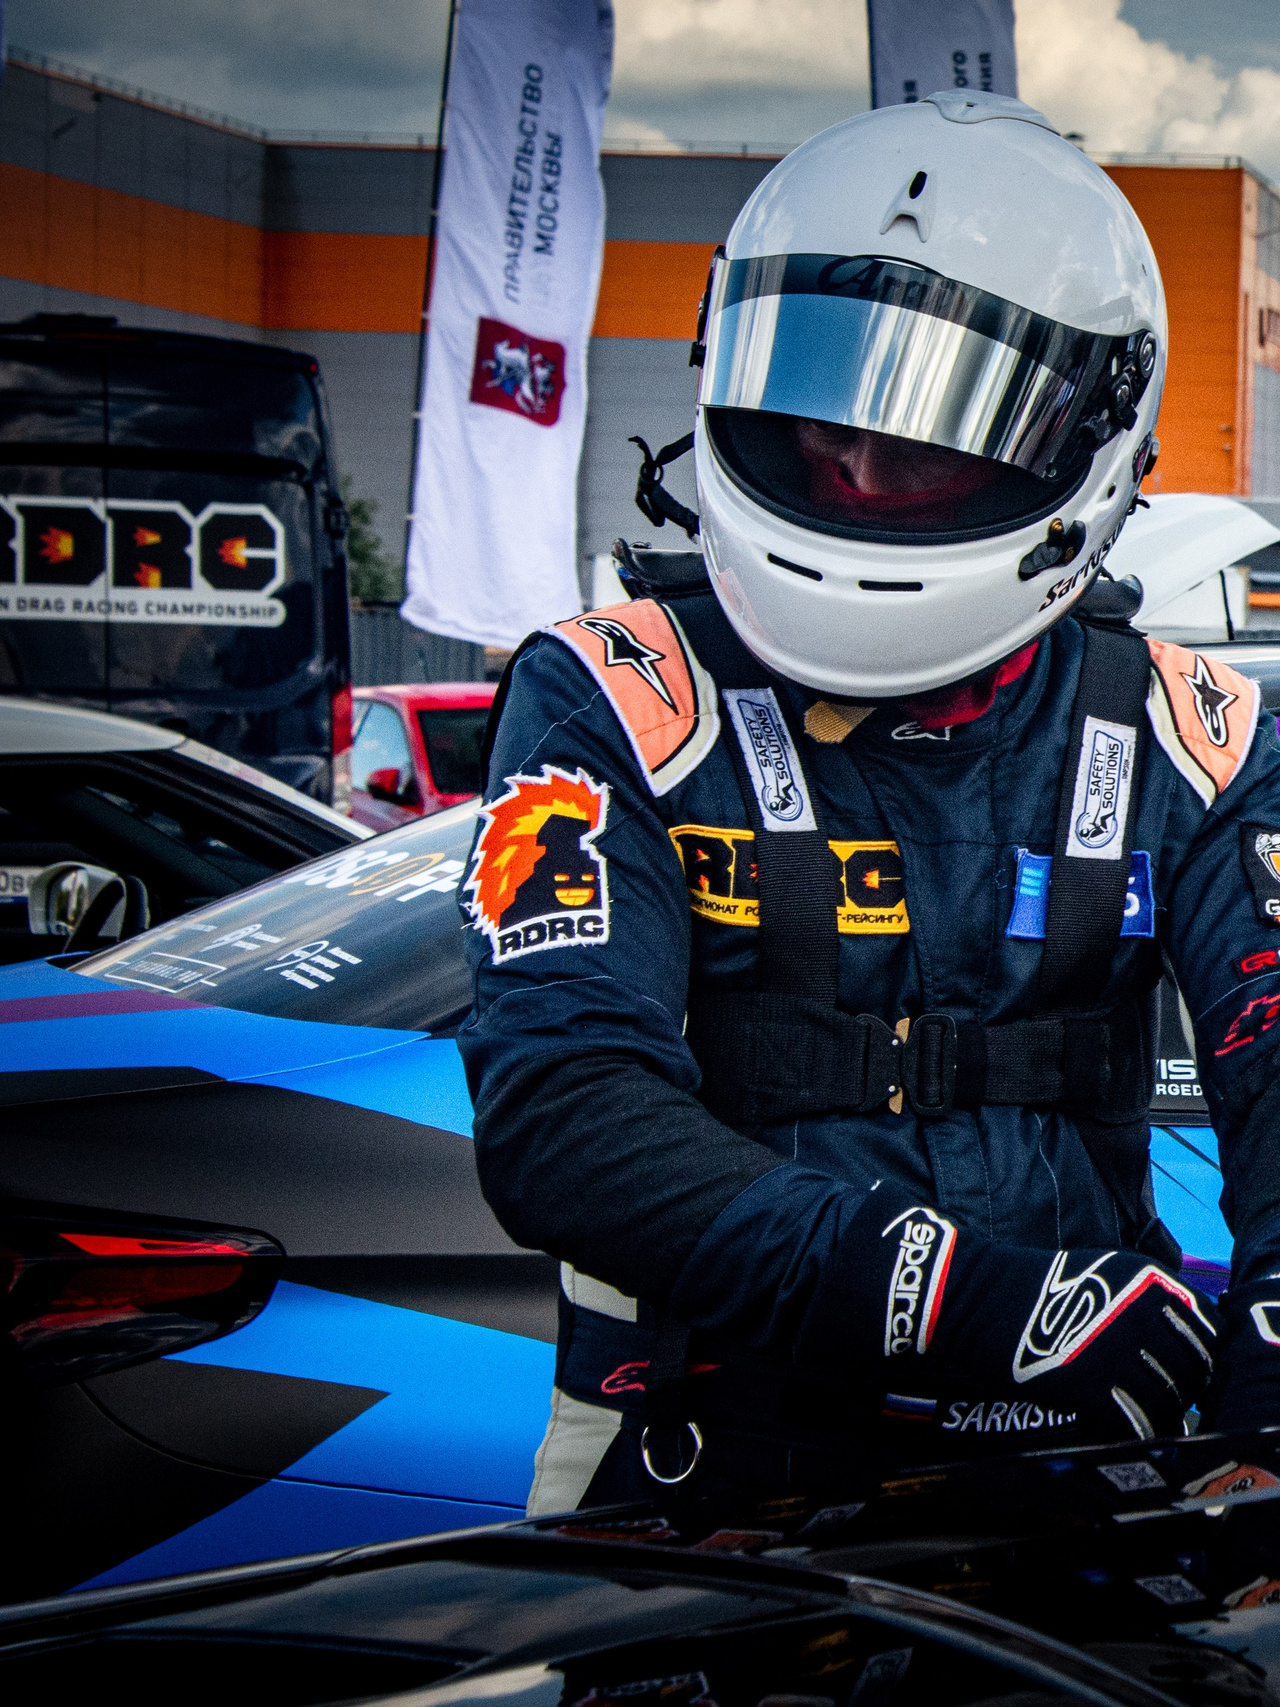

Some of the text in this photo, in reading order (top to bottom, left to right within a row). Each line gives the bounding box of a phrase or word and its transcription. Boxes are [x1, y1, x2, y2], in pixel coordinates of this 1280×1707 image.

[503, 63, 544, 304] ПРАВИТЕЛЬСТВО
[533, 131, 563, 256] МОСКВЫ
[0, 496, 284, 595] DRC
[16, 597, 66, 613] DRAG
[72, 599, 138, 615] RACING
[144, 601, 279, 619] CHAMPIONSHIP
[748, 717, 772, 769] SAFETY
[757, 707, 789, 780] SOLUTIONS
[1089, 748, 1106, 797] SAFETY
[1102, 742, 1120, 809] SOLUTIONS
[498, 914, 605, 956] RDRC
[891, 1223, 936, 1354] sparco
